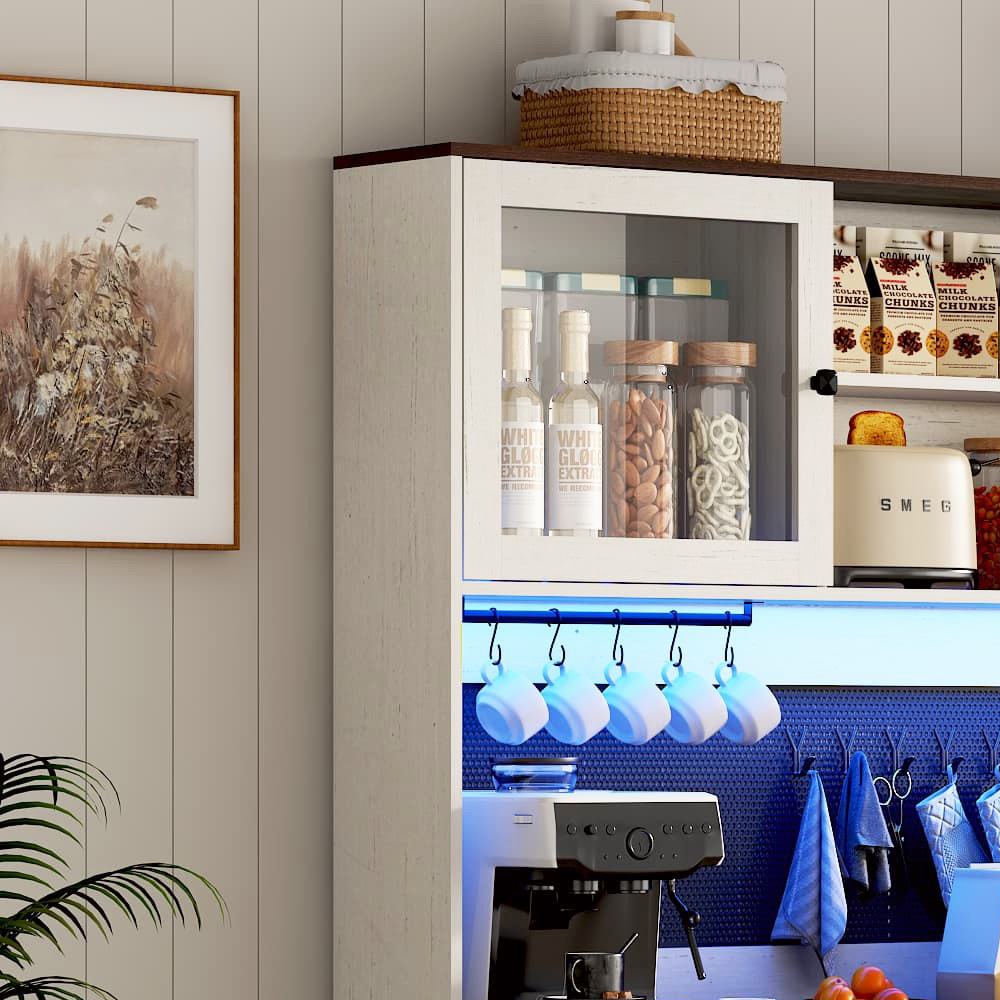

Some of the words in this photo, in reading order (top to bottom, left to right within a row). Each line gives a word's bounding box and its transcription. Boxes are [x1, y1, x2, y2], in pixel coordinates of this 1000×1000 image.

[883, 291, 934, 299] CHOCOLATE
[885, 298, 935, 308] CHUNKS
[938, 302, 996, 311] CHUNKS
[501, 428, 541, 446] WHI
[557, 430, 600, 448] WHI
[501, 446, 544, 465] GLØ
[559, 448, 601, 466] GLØ
[880, 498, 951, 512] SMEG
